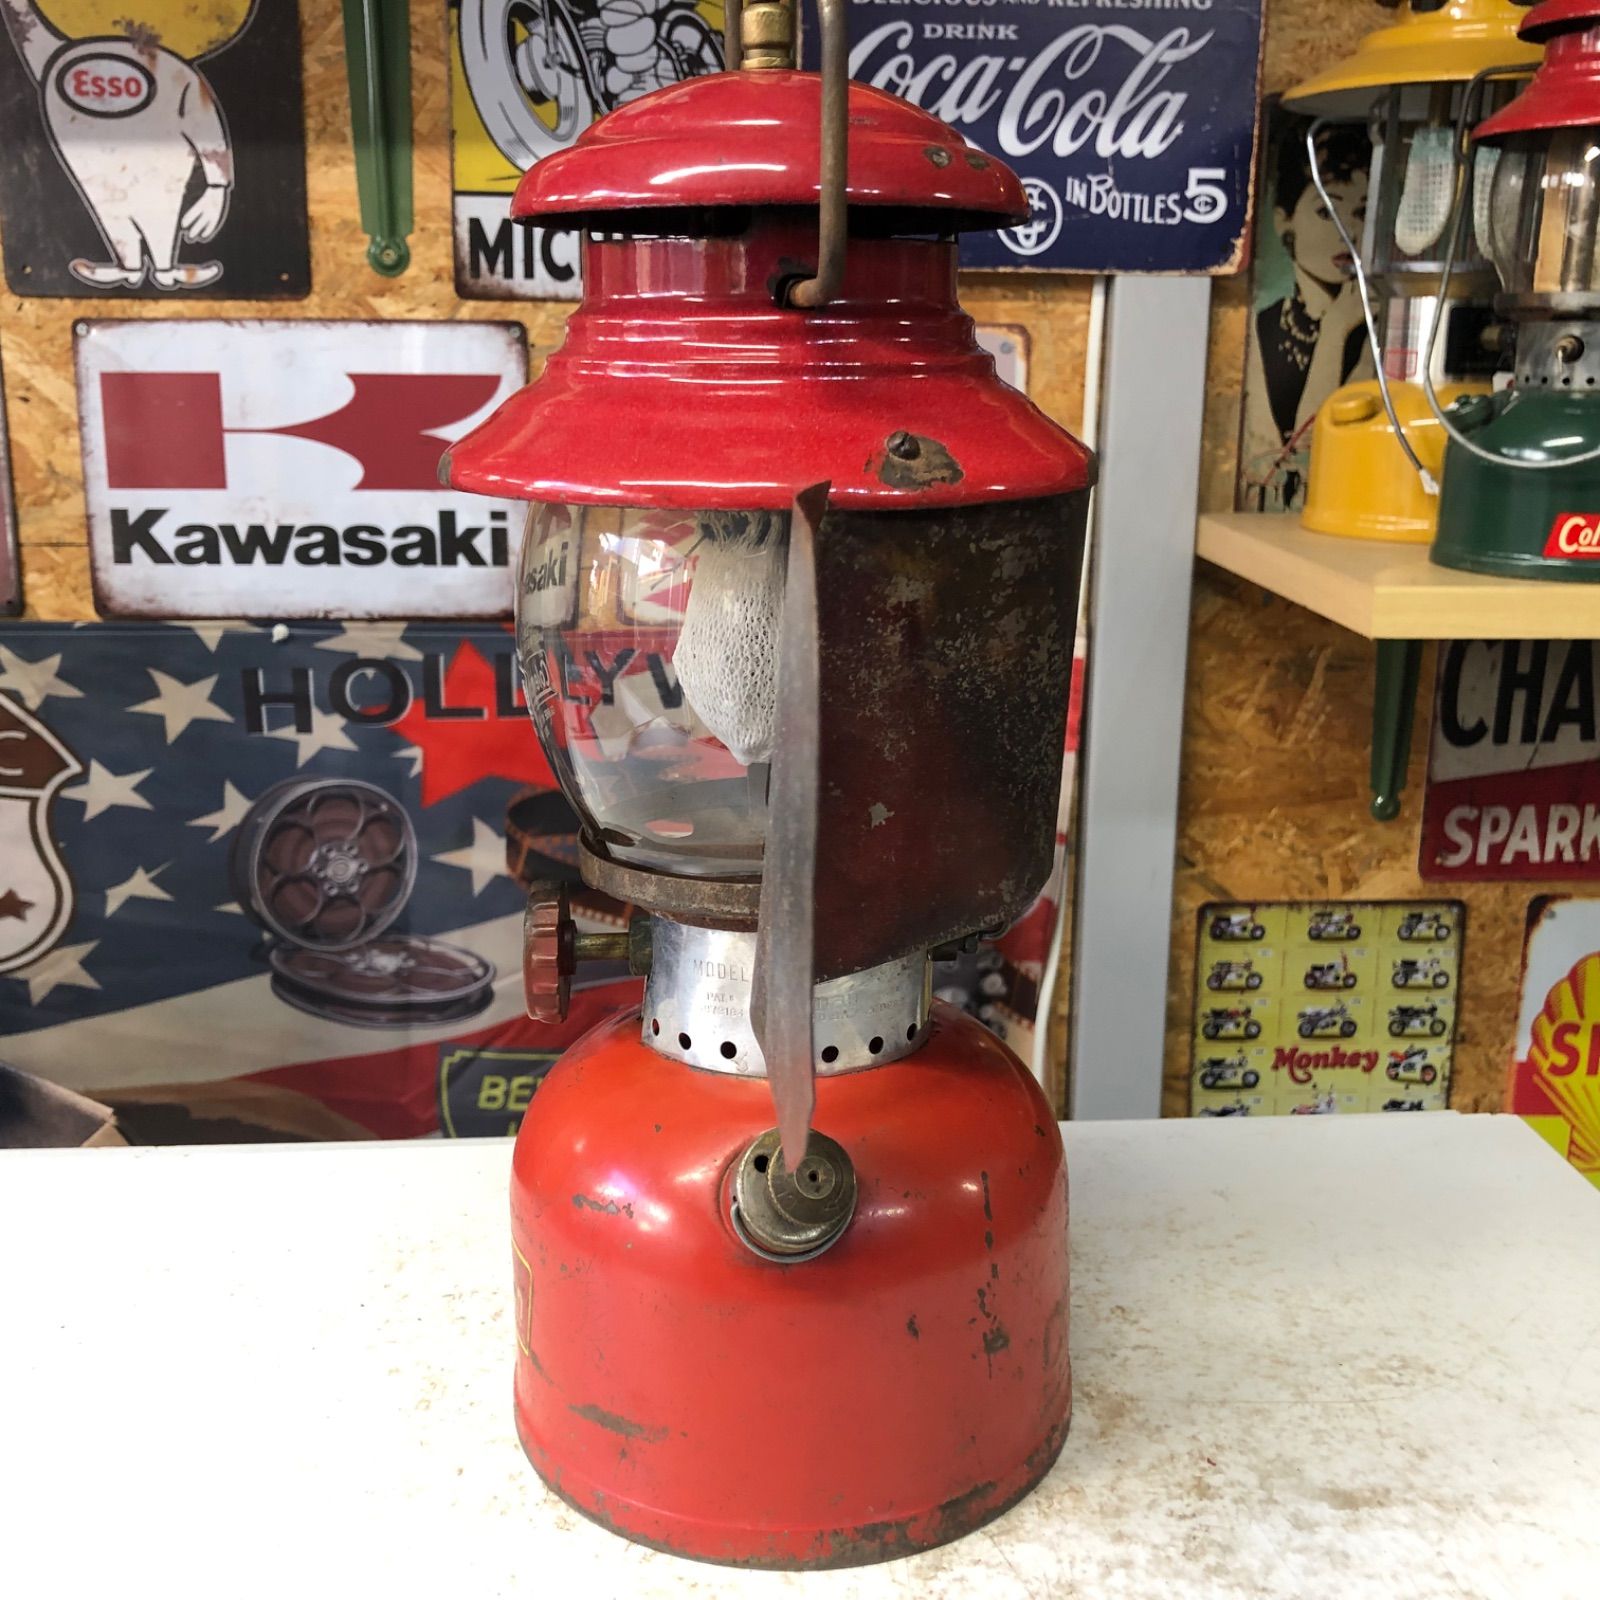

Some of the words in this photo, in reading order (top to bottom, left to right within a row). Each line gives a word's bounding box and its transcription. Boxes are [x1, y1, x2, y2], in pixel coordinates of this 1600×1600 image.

[923, 24, 1019, 40] DRINK
[848, 20, 1214, 158] Coca-Cola
[1065, 176, 1087, 209] IN
[1087, 173, 1182, 225] BOTTLES
[469, 217, 582, 282] MIC
[110, 509, 510, 567] Kawasaki
[1441, 640, 1597, 747] CHA
[693, 960, 750, 982] MODEL
[1271, 1043, 1379, 1084] Monkey
[477, 1074, 543, 1112] BE
